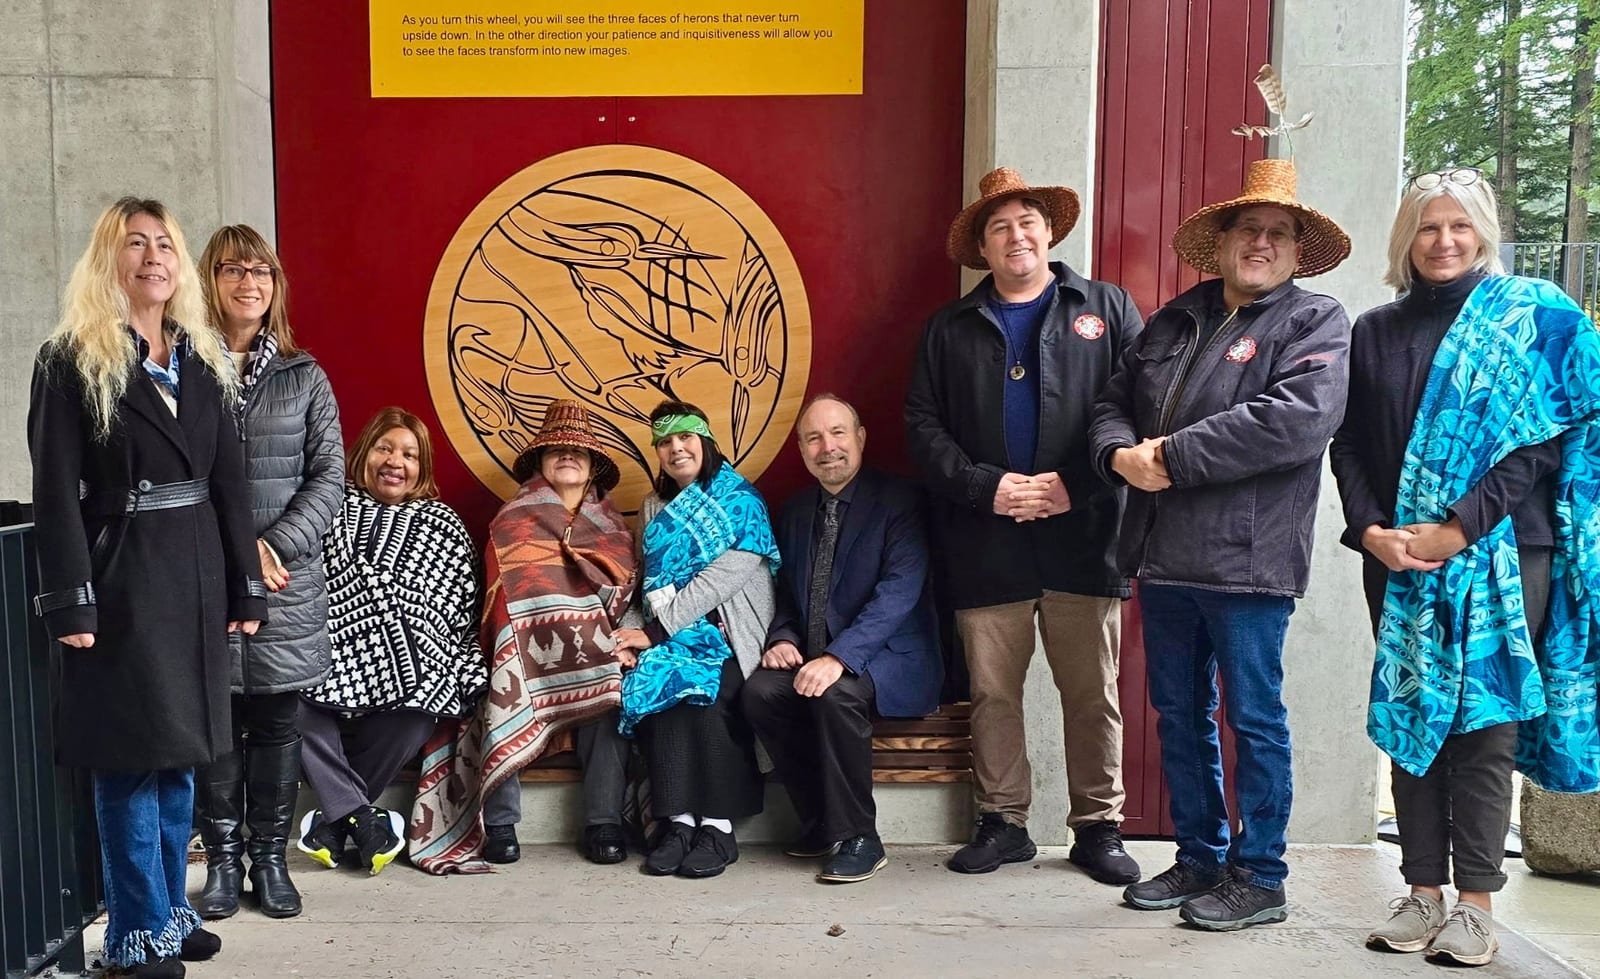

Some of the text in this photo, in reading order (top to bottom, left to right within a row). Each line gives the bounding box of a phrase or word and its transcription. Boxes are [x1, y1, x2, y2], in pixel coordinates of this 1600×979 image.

[401, 13, 800, 28] As you turn this wheel, you will see the three faces of herons that never turn
[402, 28, 833, 43] upside down. In the other direction your patience and inquisitiveness will allow you
[402, 45, 632, 59] to see the faces transform into new images.
